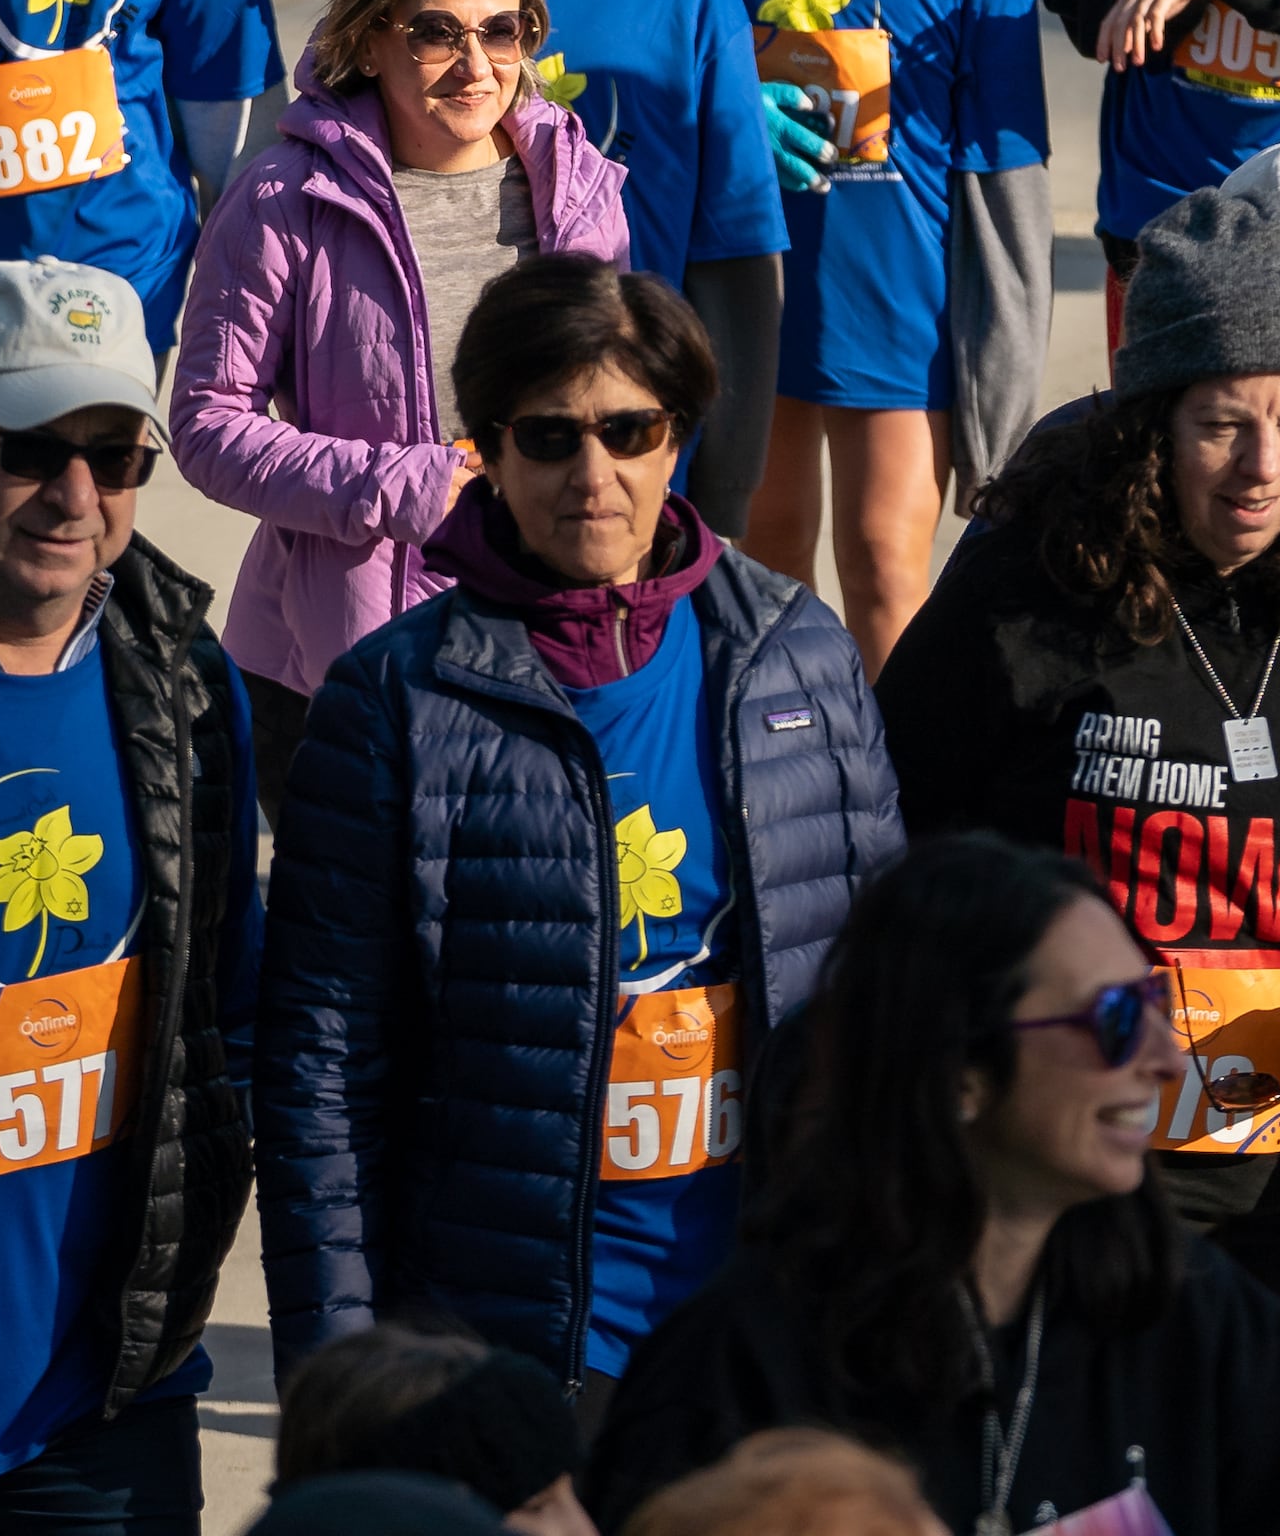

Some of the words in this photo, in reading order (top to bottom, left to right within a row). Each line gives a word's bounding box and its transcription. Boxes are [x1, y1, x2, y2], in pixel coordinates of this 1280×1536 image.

[71, 332, 101, 345] 2011
[1075, 712, 1161, 758] BRING
[1072, 750, 1145, 801] THEM
[1147, 760, 1228, 808] HOME
[19, 1014, 76, 1035] OnTime
[1171, 1006, 1220, 1022] nTime
[653, 1026, 709, 1045] OnTime
[608, 1069, 742, 1170] 576
